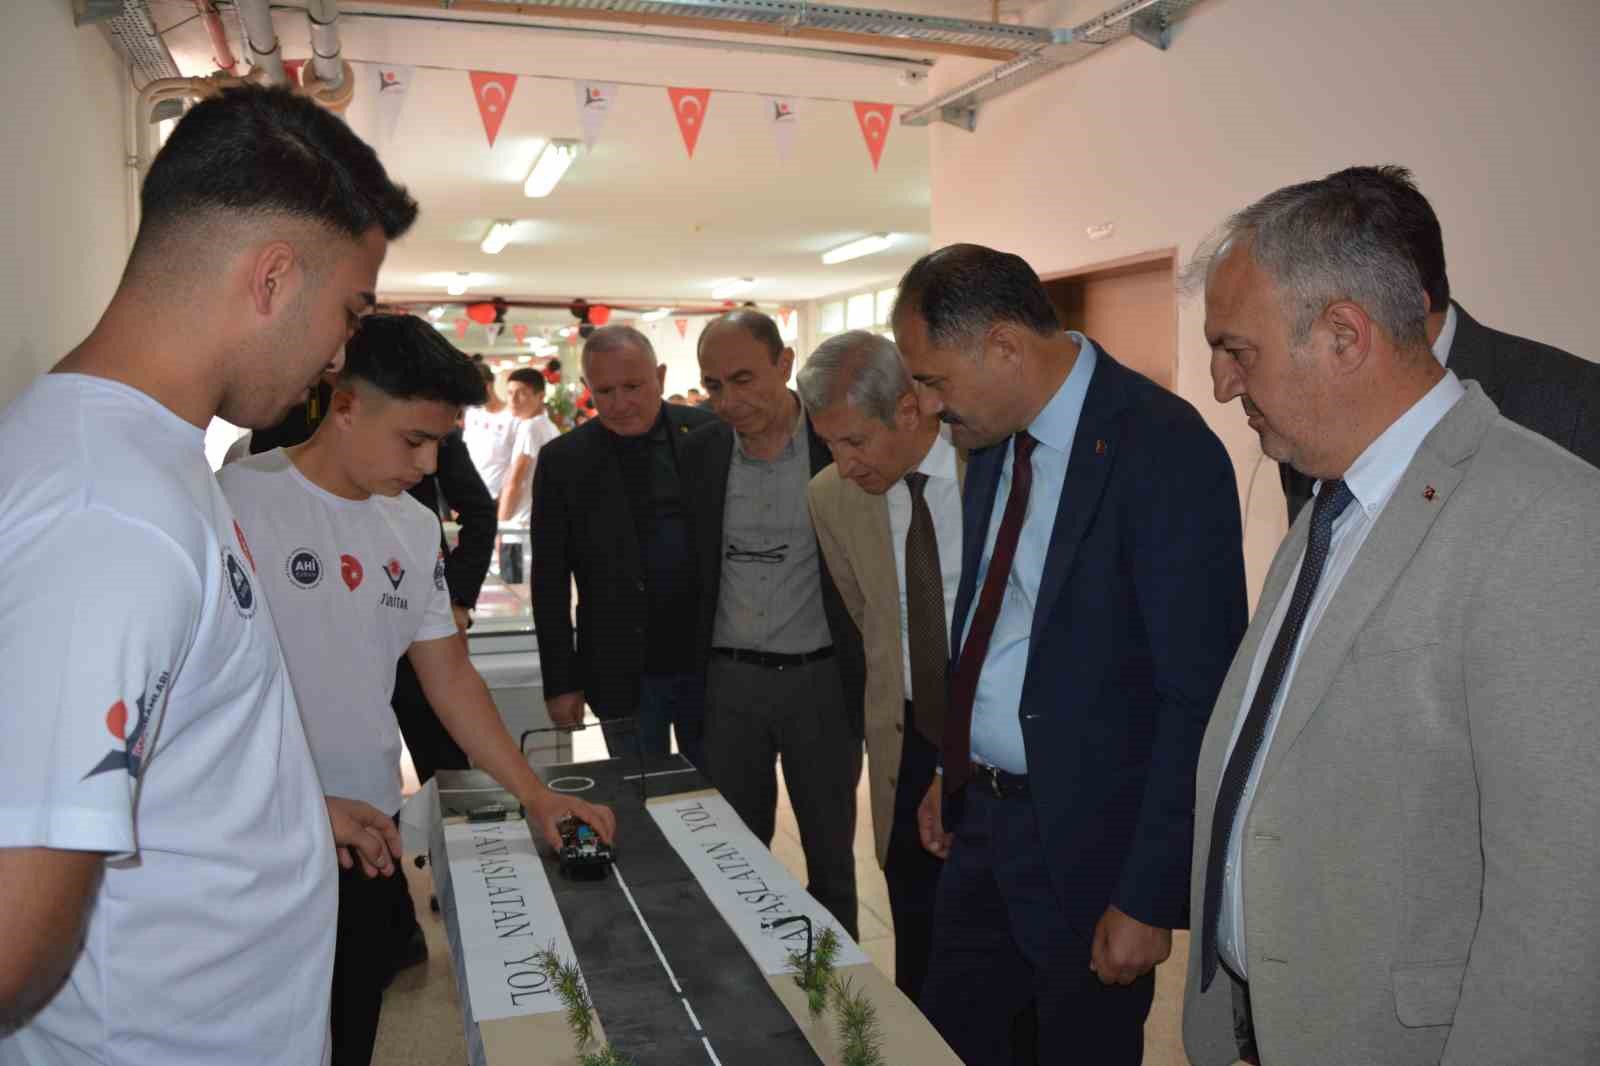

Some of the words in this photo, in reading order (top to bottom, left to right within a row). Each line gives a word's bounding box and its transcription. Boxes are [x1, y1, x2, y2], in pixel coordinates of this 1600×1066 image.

[295, 558, 316, 572] AHİ
[676, 802, 717, 833] YOL
[472, 825, 534, 939] YAVAŞLATAN
[504, 951, 551, 1007] YOL
